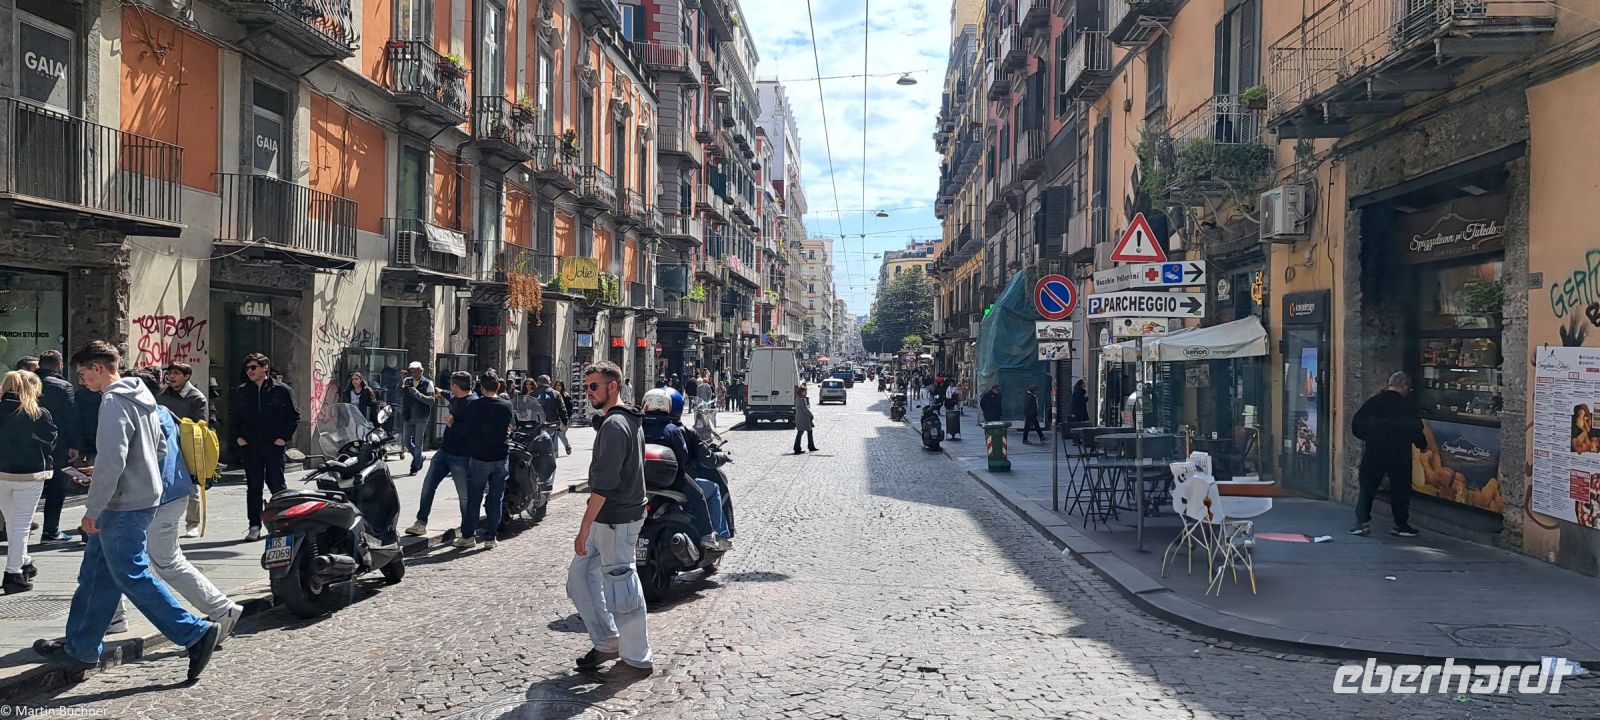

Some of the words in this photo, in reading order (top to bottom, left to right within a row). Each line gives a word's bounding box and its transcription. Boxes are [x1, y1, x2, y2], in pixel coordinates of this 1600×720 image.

[24, 51, 66, 80] GAIA
[256, 134, 278, 153] GAIA
[567, 264, 593, 281] Jolie
[245, 301, 271, 317] GAIA
[1090, 299, 1100, 314] P
[1104, 296, 1177, 313] PARCHEGGIO
[272, 537, 283, 548] DS
